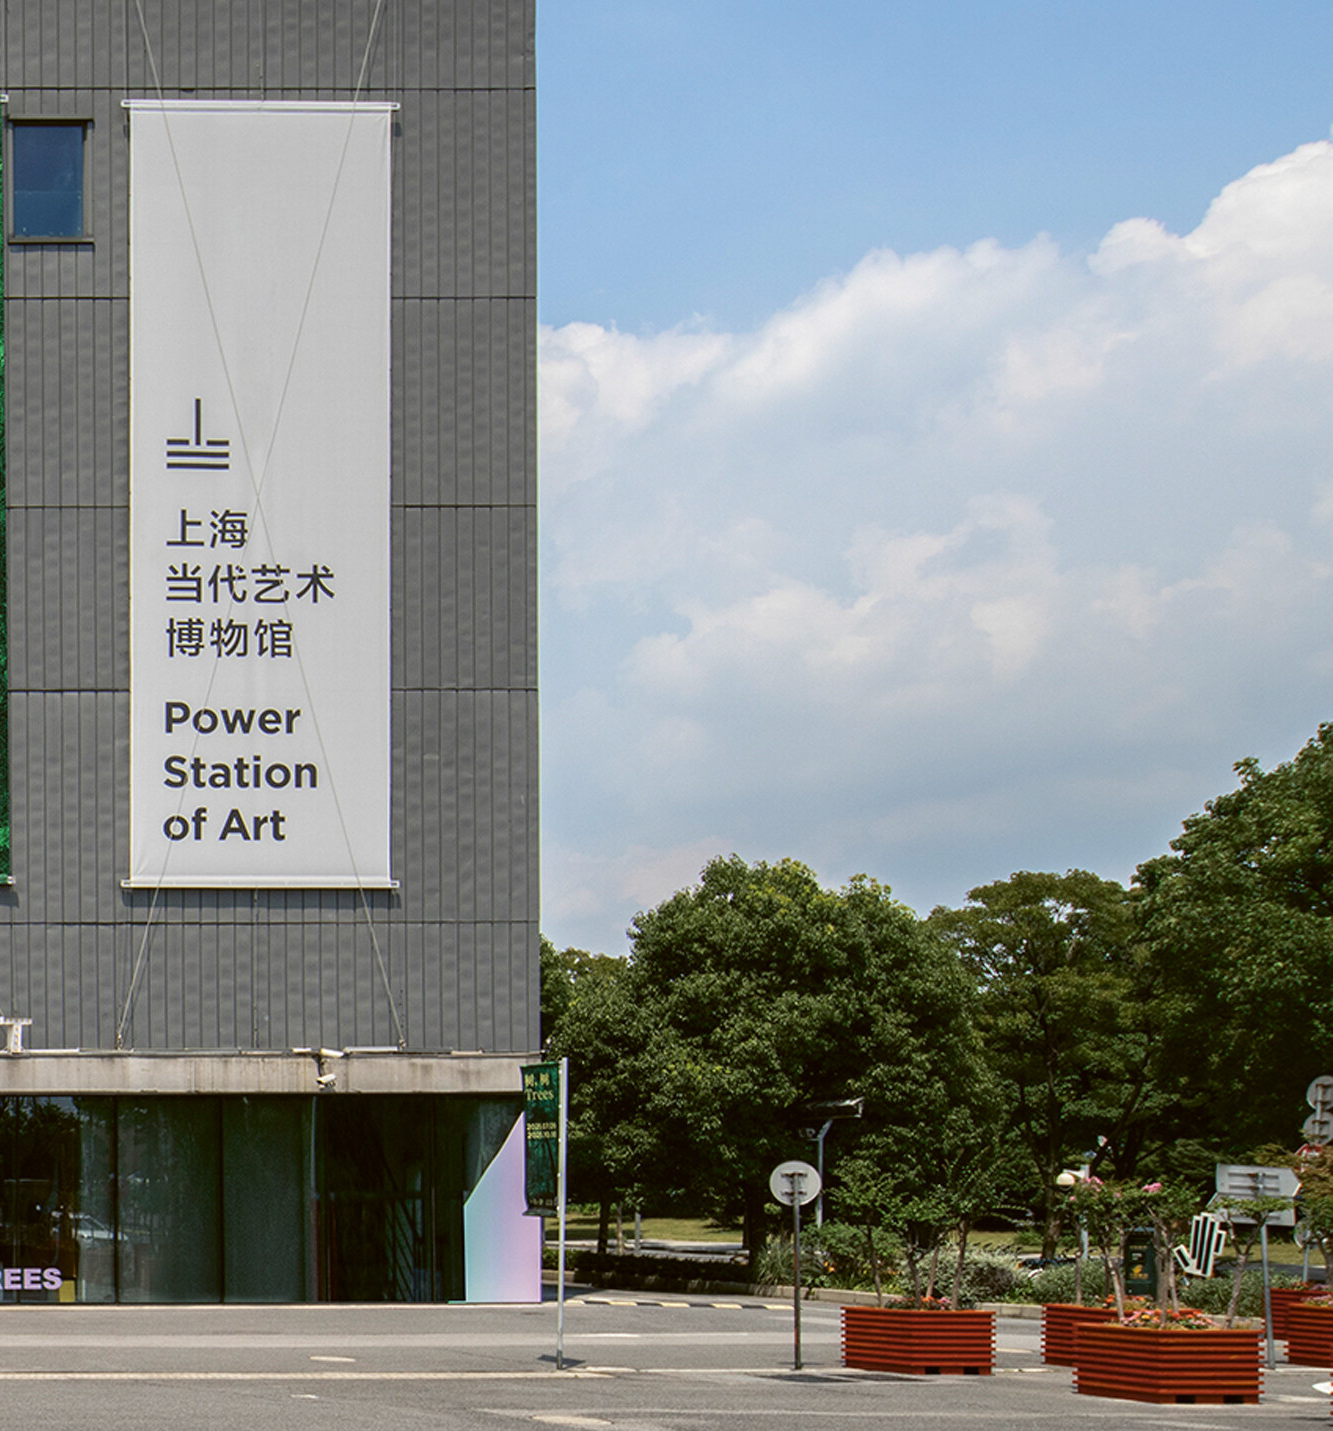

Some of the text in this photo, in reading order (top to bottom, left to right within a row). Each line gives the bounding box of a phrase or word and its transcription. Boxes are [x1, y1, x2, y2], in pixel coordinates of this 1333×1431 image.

[166, 509, 248, 548] 上海
[166, 563, 336, 604] 当代艺术
[166, 618, 293, 658] 博物馆
[165, 702, 301, 734] Power
[164, 755, 318, 788] Station
[164, 807, 286, 841] of Art
